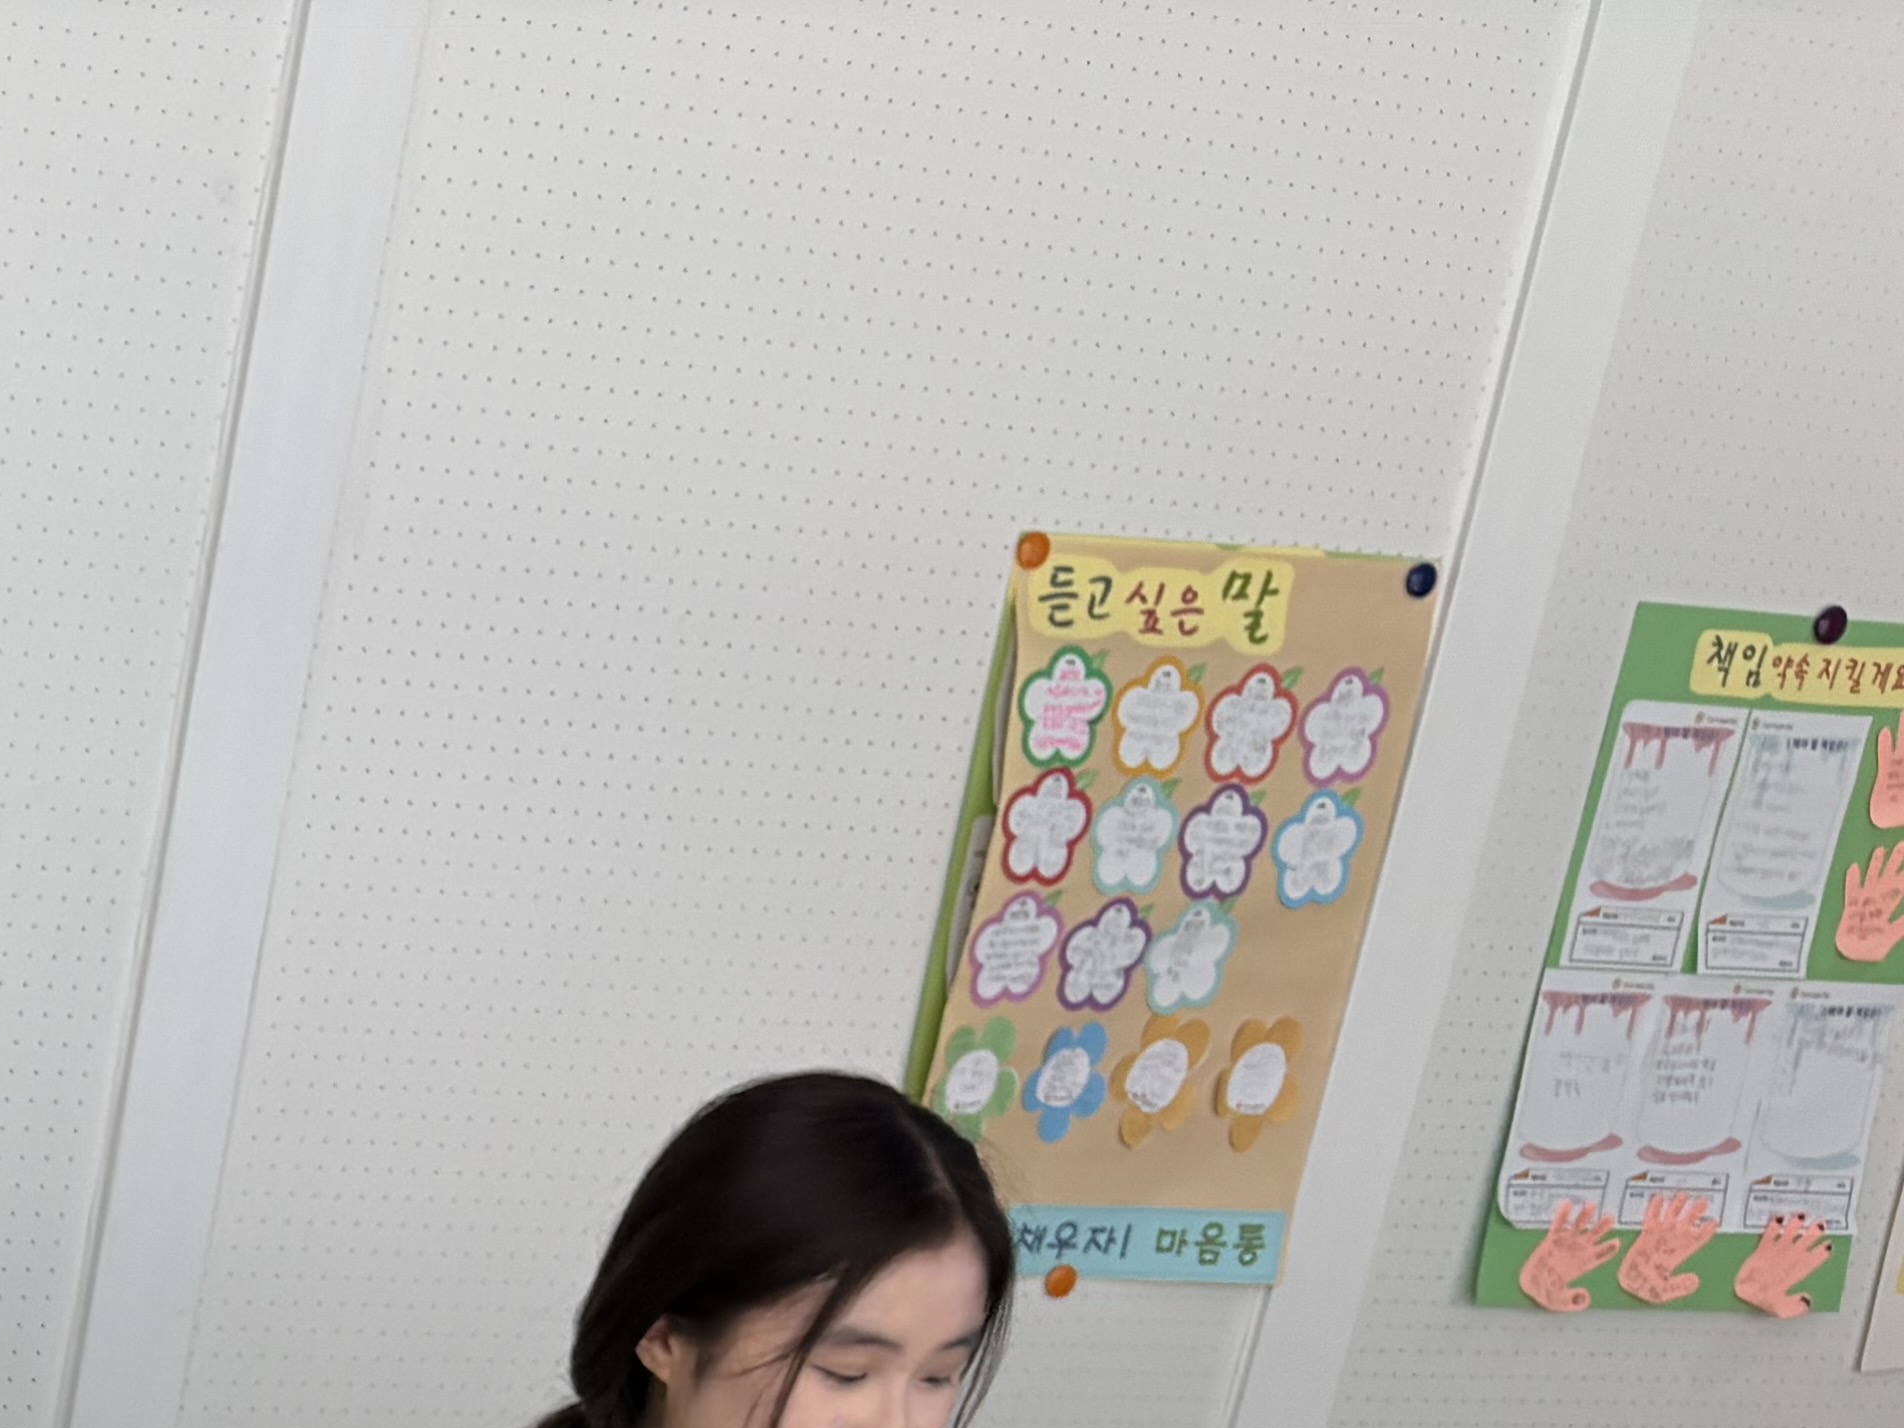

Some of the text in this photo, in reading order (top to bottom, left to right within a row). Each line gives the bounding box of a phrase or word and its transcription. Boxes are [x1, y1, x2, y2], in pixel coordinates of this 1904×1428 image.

[1038, 564, 1279, 645] 듣고 싶은 말
[1706, 634, 1769, 689] 책임
[1155, 1221, 1266, 1267] 마음통
